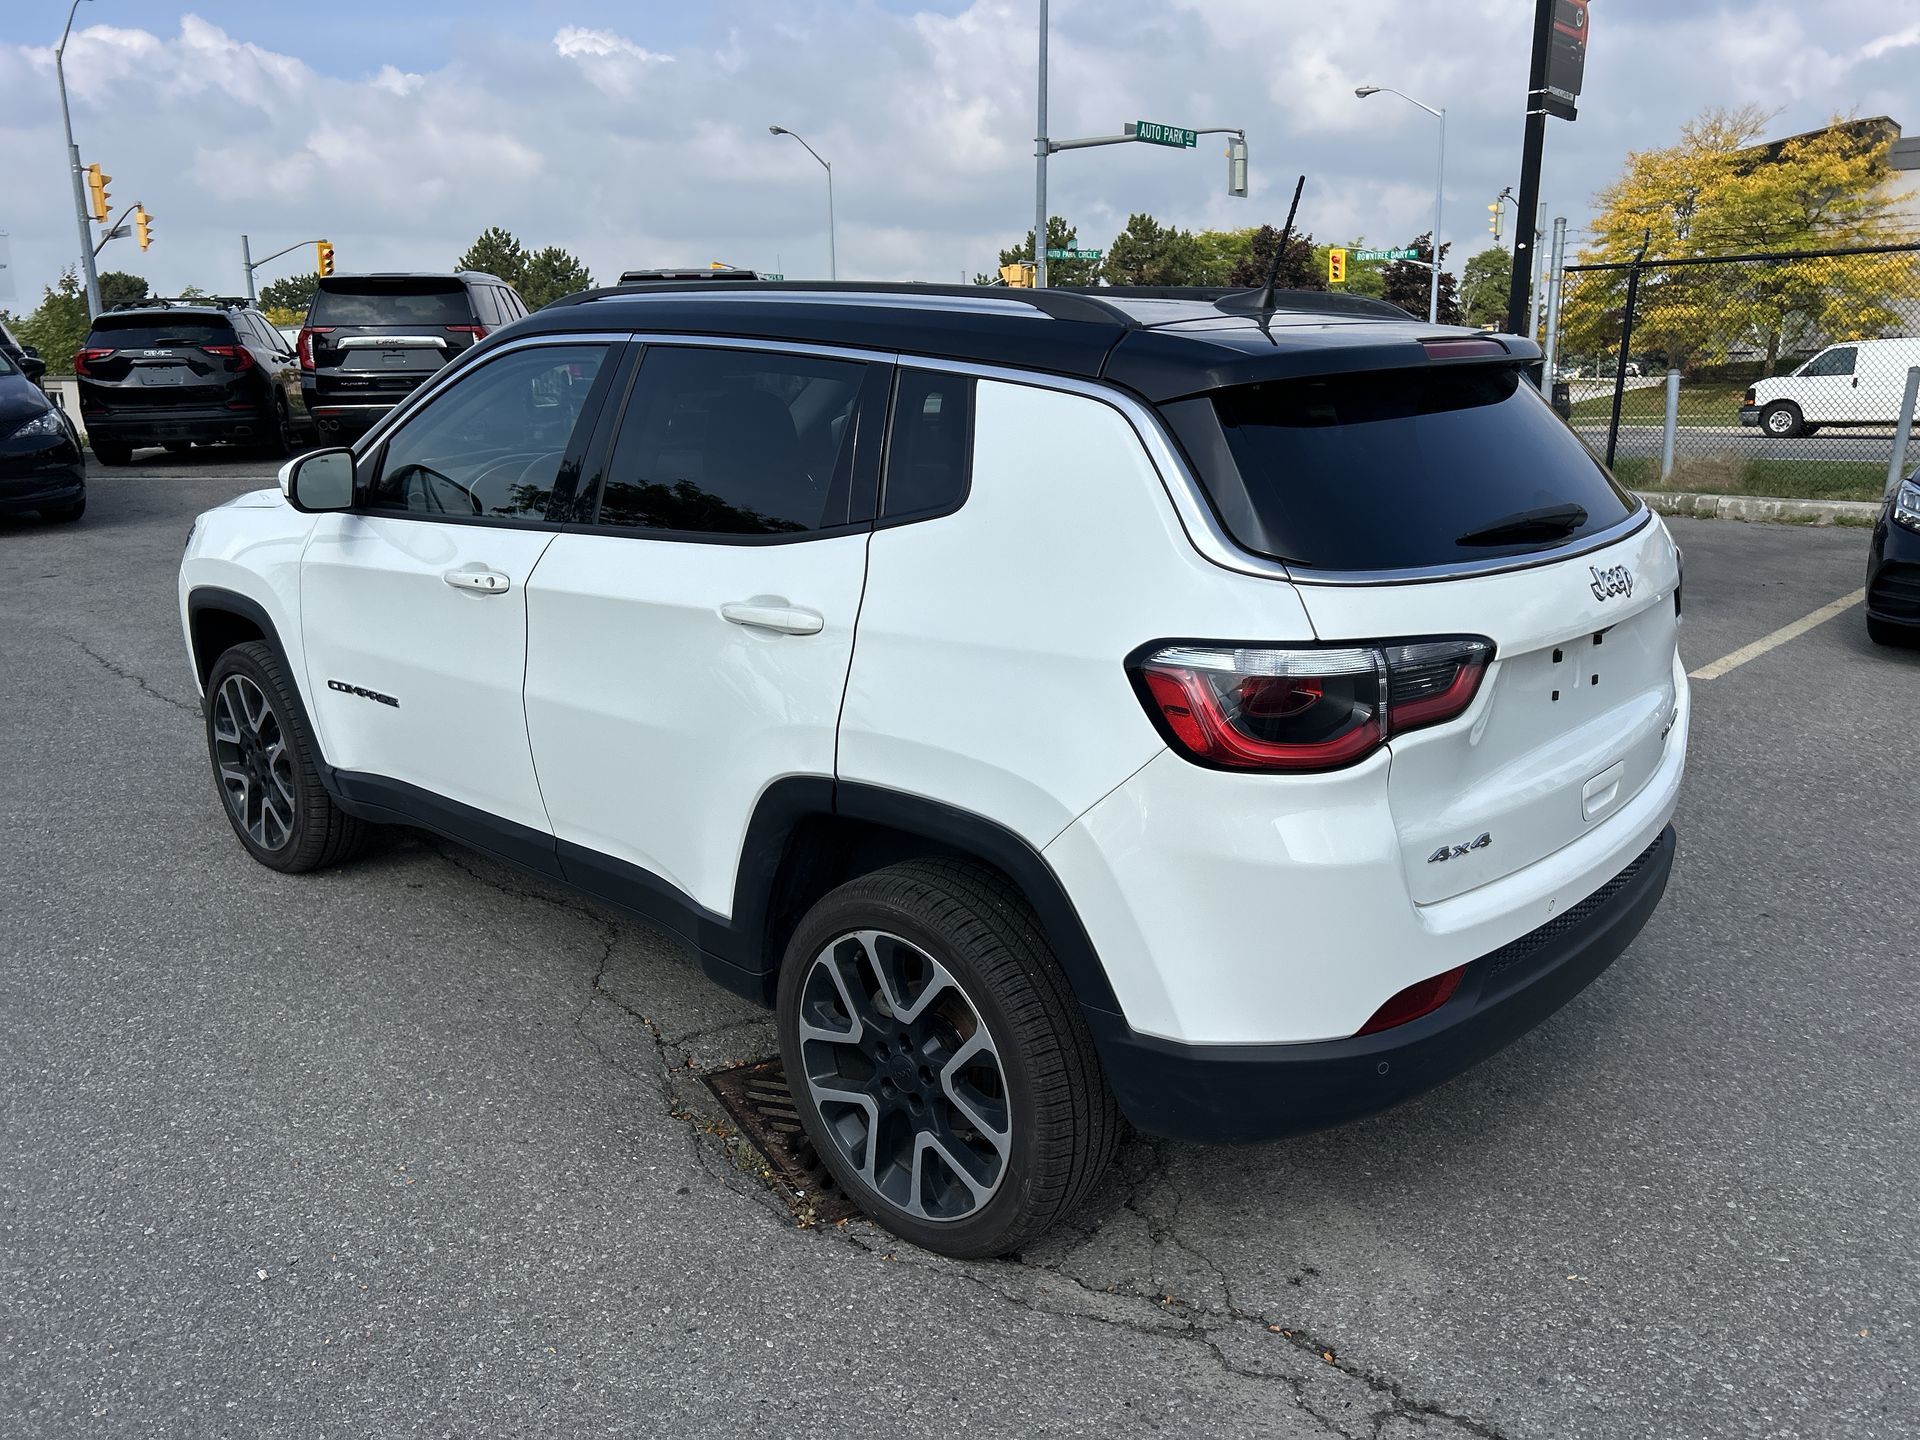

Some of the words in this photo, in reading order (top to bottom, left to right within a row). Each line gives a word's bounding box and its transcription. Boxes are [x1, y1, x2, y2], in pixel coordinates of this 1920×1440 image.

[1140, 123, 1161, 140] AUTO
[1163, 127, 1184, 144] PARK
[1186, 131, 1195, 141] CIR
[1047, 250, 1061, 258] AUTO
[1062, 250, 1077, 258] PARK
[1078, 251, 1098, 259] CIRCLE
[1356, 251, 1389, 261] ROWNTREE
[1390, 250, 1408, 259] DAIRY
[1590, 564, 1633, 601] Jeep
[327, 680, 400, 708] COMPASS
